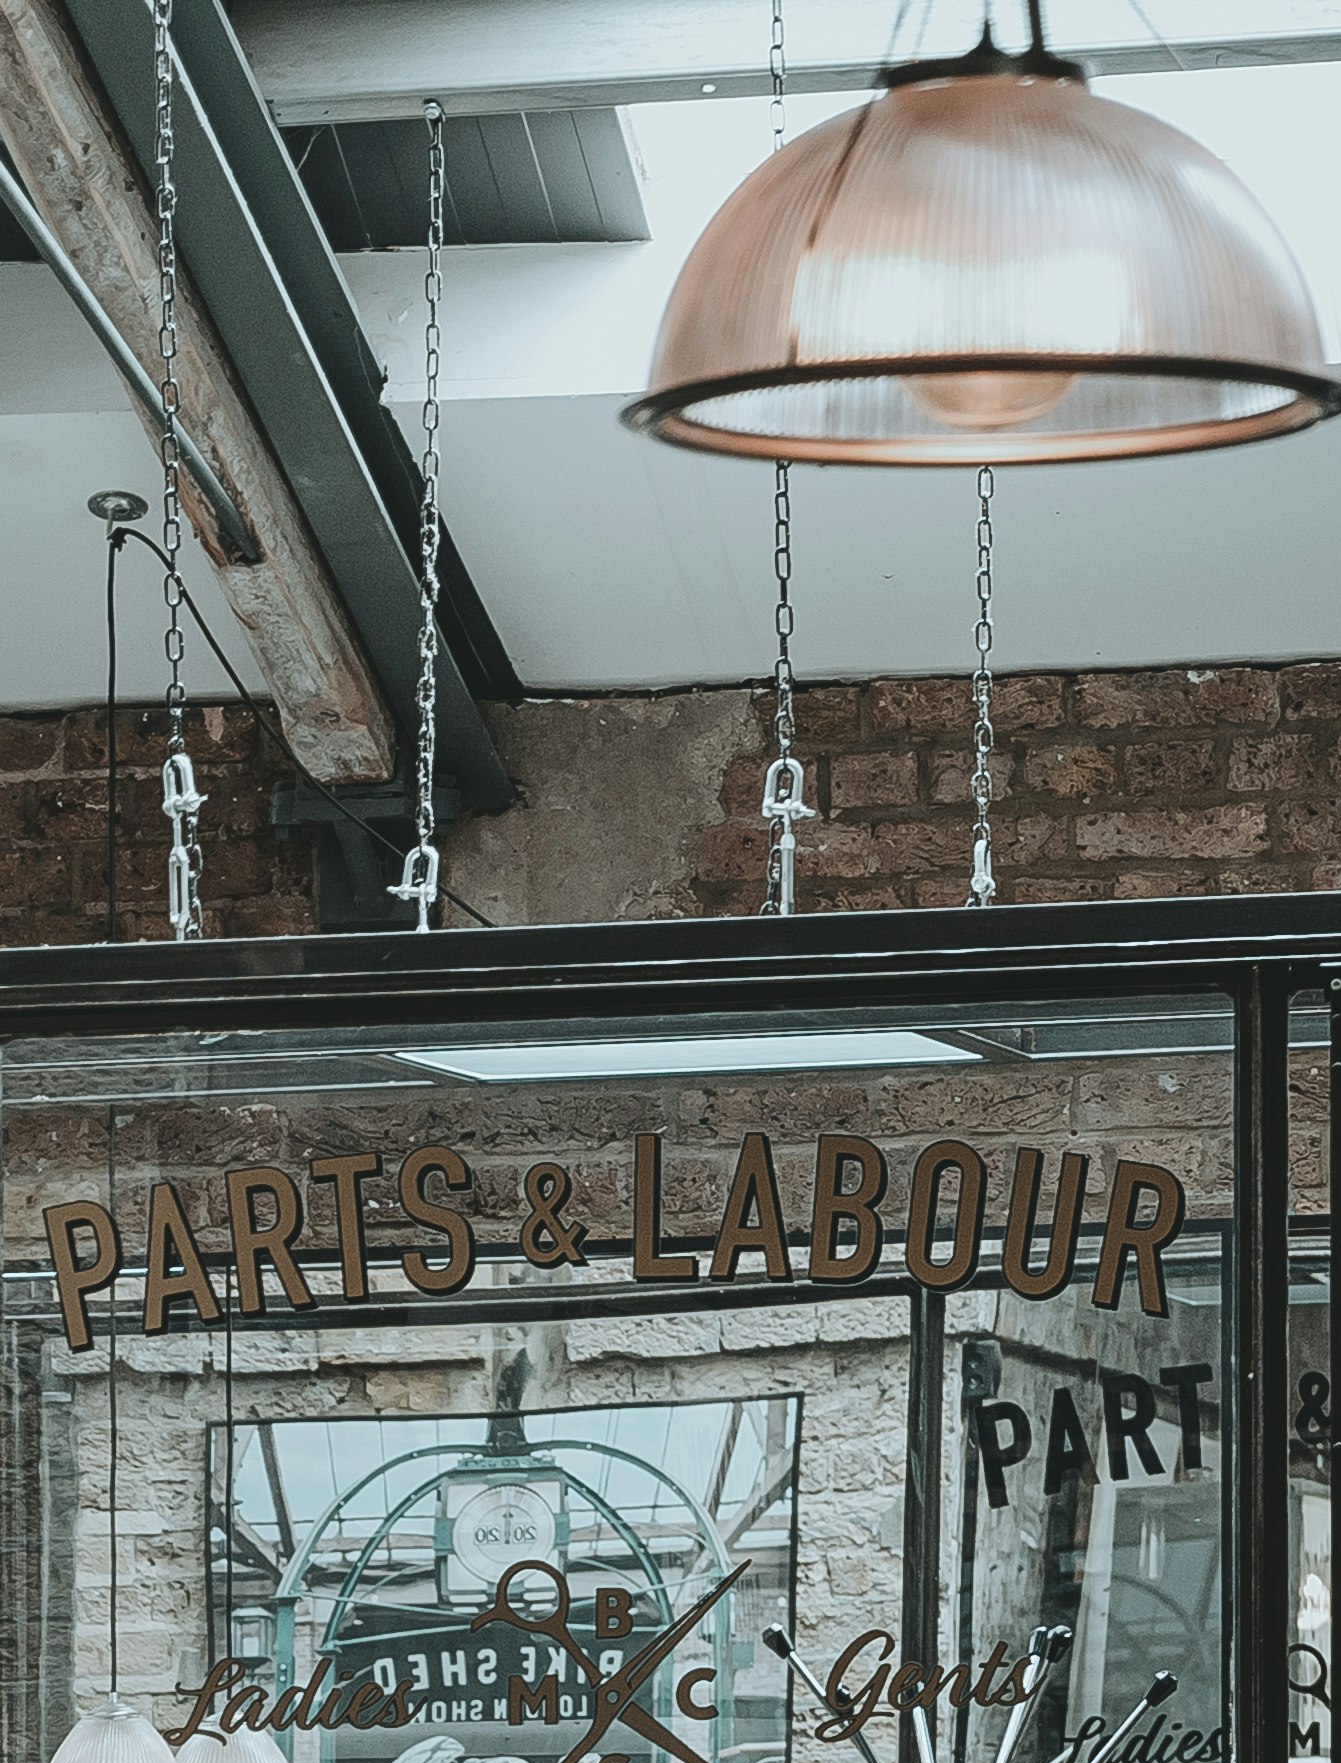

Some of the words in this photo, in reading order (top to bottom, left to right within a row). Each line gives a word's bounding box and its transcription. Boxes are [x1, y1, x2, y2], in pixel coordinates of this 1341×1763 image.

[43, 1143, 476, 1352] PARTS
[519, 1161, 589, 1266] &
[632, 1131, 1187, 1319] LABOUR
[976, 1362, 1214, 1509] PART
[595, 1587, 635, 1640] B
[162, 1656, 428, 1748] Ladies
[508, 1674, 559, 1726] M
[676, 1667, 720, 1720] C
[814, 1628, 1047, 1744] Gents
